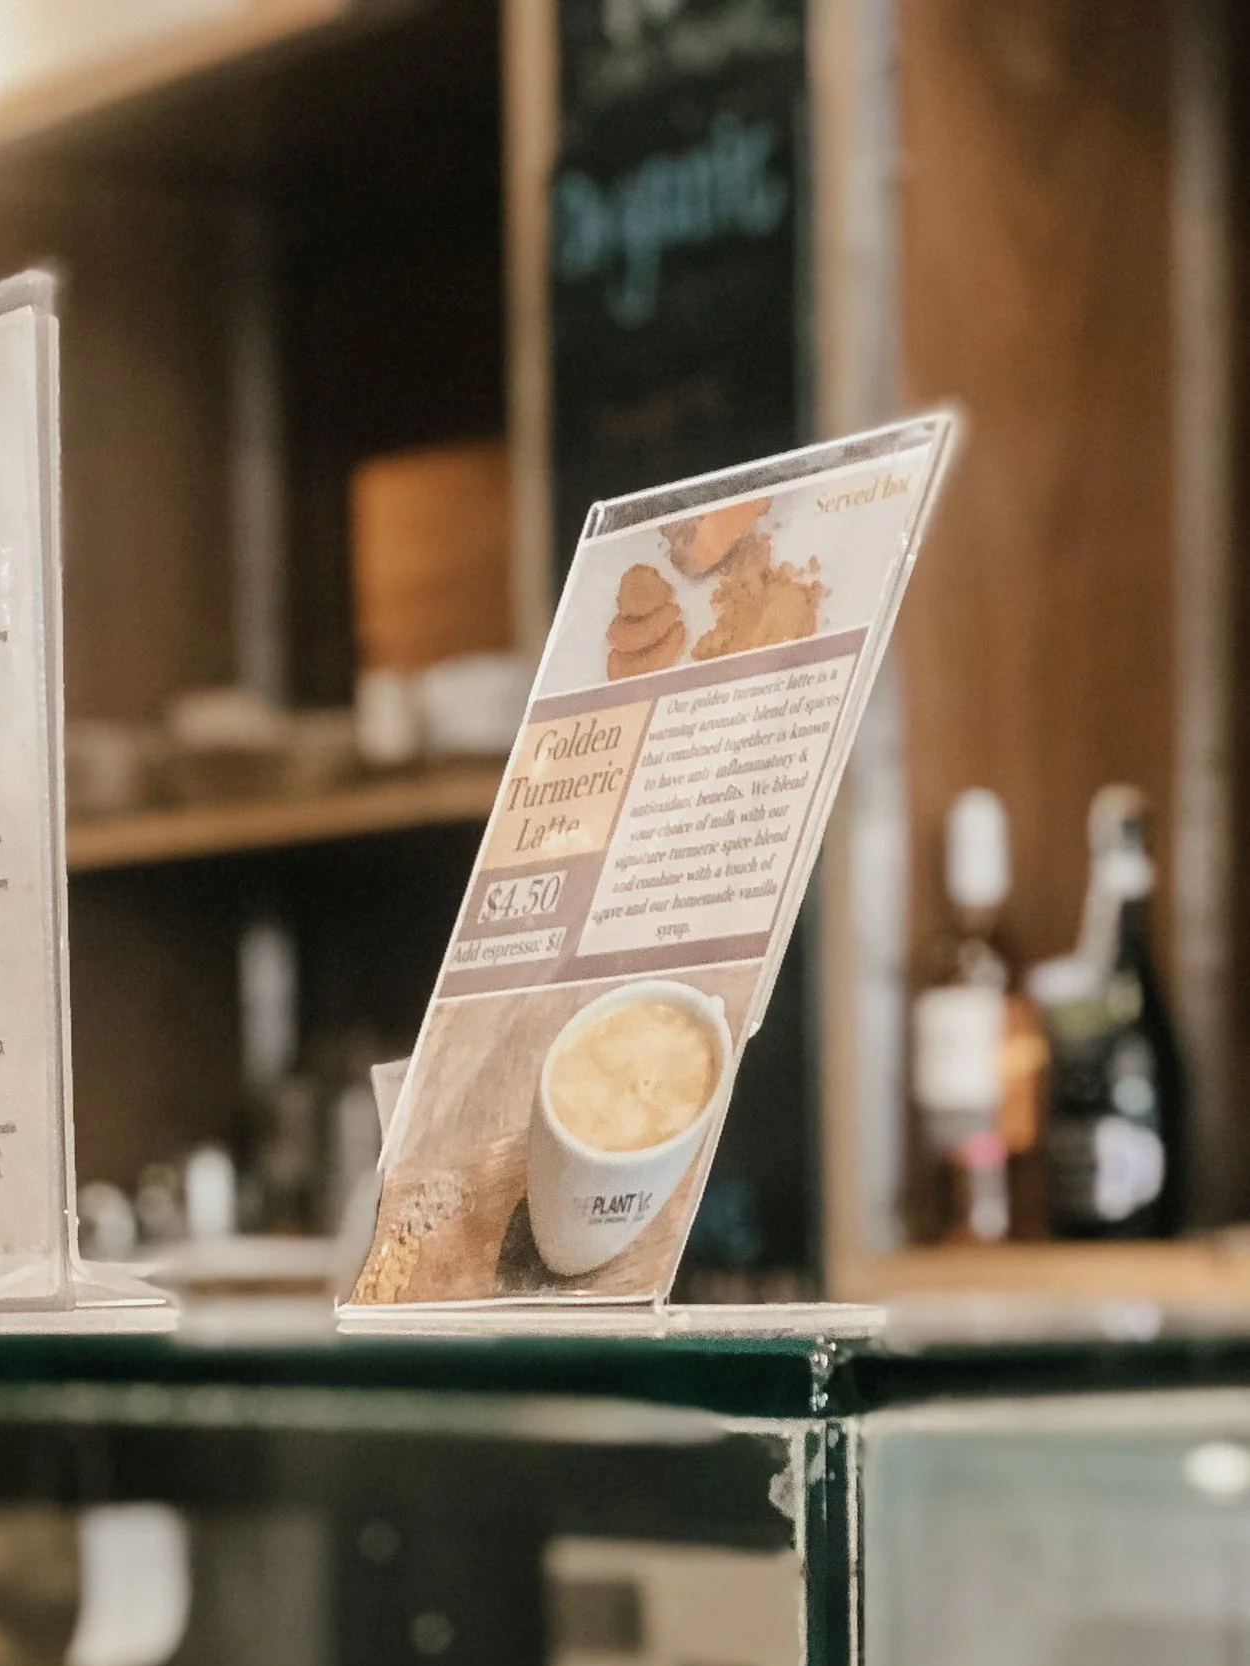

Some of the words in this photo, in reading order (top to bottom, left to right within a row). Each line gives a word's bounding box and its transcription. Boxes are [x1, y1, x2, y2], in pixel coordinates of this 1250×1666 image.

[813, 477, 879, 516] Served
[667, 699, 689, 715] Our
[690, 689, 730, 714] golden
[732, 678, 785, 701] turmeric
[786, 672, 815, 690] latte
[817, 668, 827, 683] is
[830, 669, 839, 681] a
[649, 723, 697, 741] warming
[752, 698, 788, 721] blend
[789, 696, 806, 715] of
[805, 693, 840, 717] spices
[534, 718, 621, 763] Golden
[641, 751, 665, 767] that
[667, 737, 722, 762] combined
[724, 730, 775, 755] together
[777, 729, 786, 741] is
[789, 721, 830, 740] known
[506, 760, 624, 812] Turmeric
[644, 778, 656, 791] to
[658, 773, 685, 789] have
[799, 746, 809, 763] &
[696, 784, 745, 807] benefits.
[751, 779, 770, 796] We
[772, 769, 809, 794] blend
[630, 826, 656, 842] your
[657, 820, 693, 838] choice
[695, 812, 711, 830] of
[710, 808, 735, 829] milk
[740, 803, 765, 822] with
[768, 804, 790, 819] our
[615, 850, 667, 873] signature
[668, 842, 719, 860] turmeric
[721, 836, 753, 857] spice
[754, 823, 791, 847] blend
[612, 874, 637, 893] and
[636, 870, 684, 889] combine
[687, 863, 712, 881] with
[714, 867, 722, 878] a
[725, 855, 758, 877] touch
[760, 851, 777, 871] of
[481, 875, 561, 922] $4.50
[625, 898, 649, 916] and
[649, 899, 670, 913] our
[672, 885, 735, 910] homemade
[739, 878, 778, 899] vanilla
[453, 942, 481, 963] Add
[656, 922, 691, 940] syrup.
[591, 1193, 637, 1215] PLANT
